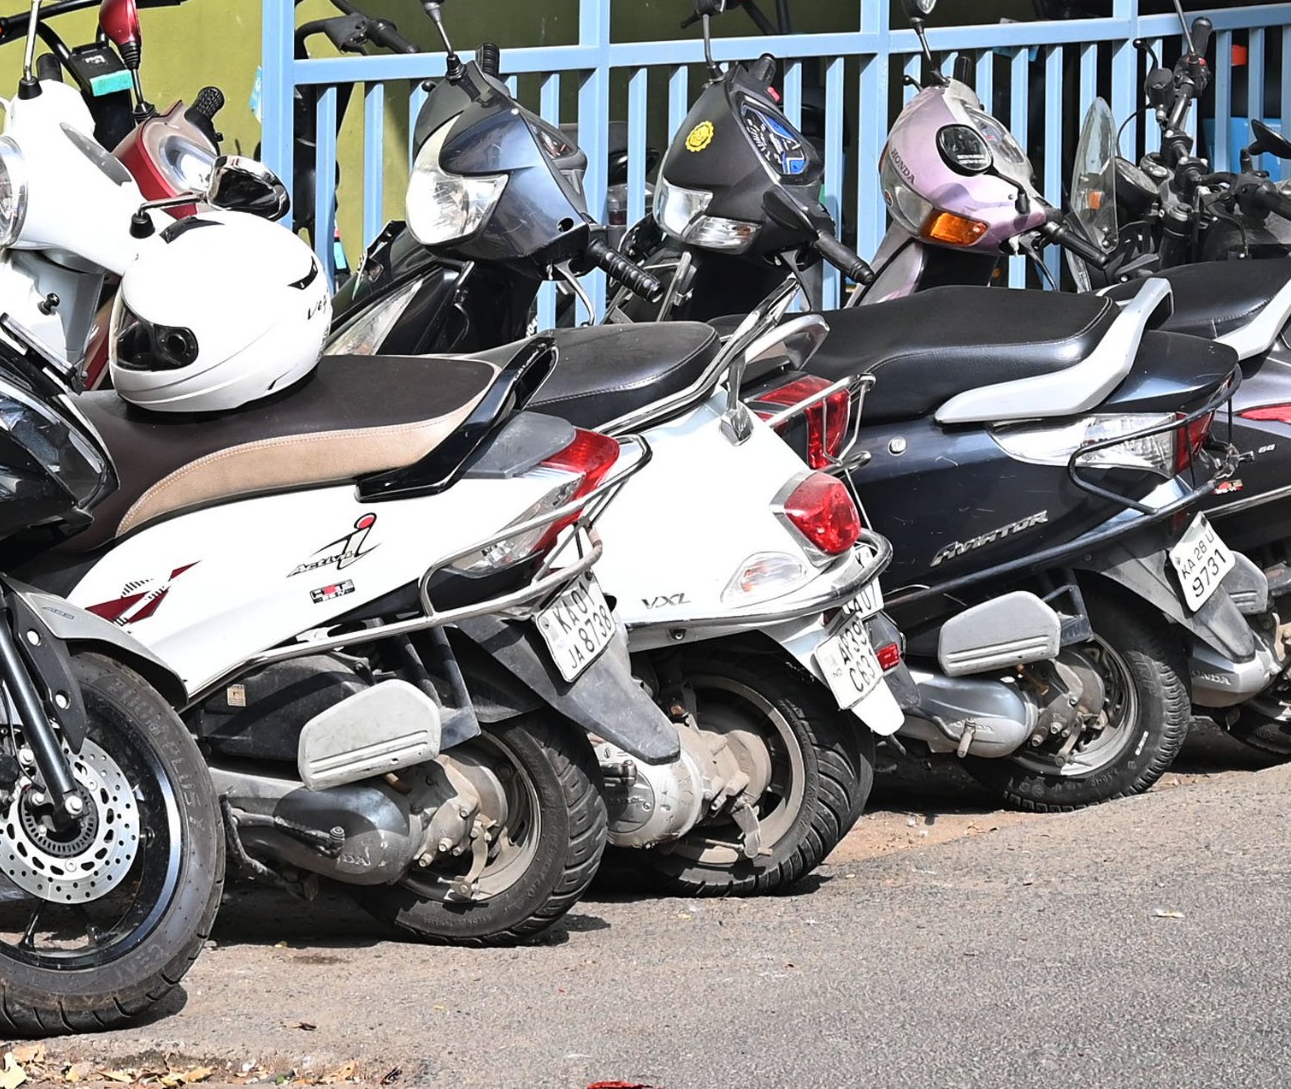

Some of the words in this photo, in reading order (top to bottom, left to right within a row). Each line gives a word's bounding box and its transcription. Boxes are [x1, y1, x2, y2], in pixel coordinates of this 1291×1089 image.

[890, 148, 916, 186] HONDA
[930, 510, 1049, 567] AVIATOR
[1192, 547, 1227, 599] 9731
[640, 592, 692, 610] VXL
